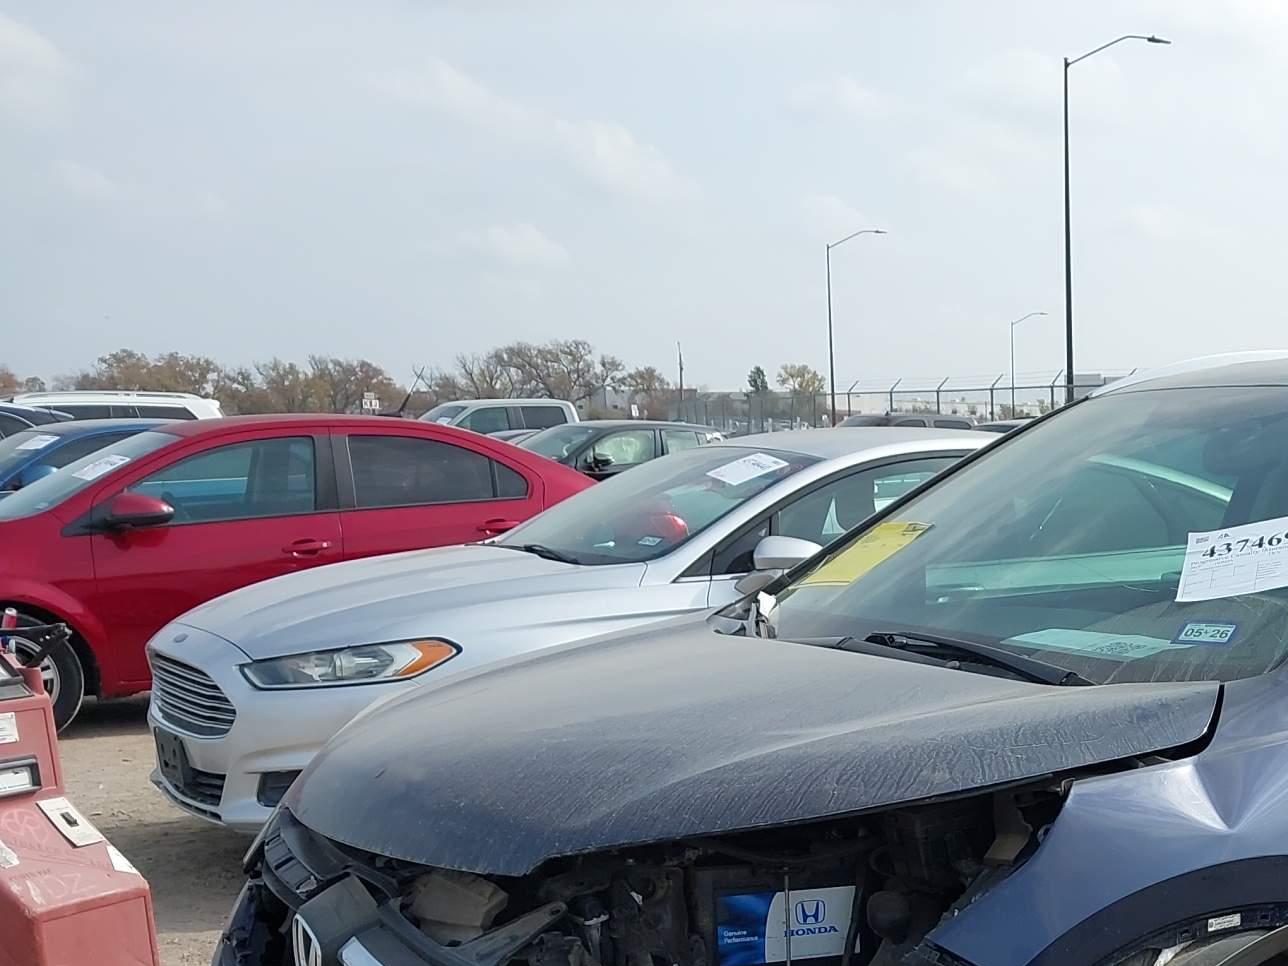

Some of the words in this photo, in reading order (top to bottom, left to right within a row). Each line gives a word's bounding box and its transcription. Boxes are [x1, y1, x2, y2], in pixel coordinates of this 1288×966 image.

[1183, 626, 1203, 638] 05
[1211, 627, 1230, 639] 26
[783, 925, 839, 938] HONDA
